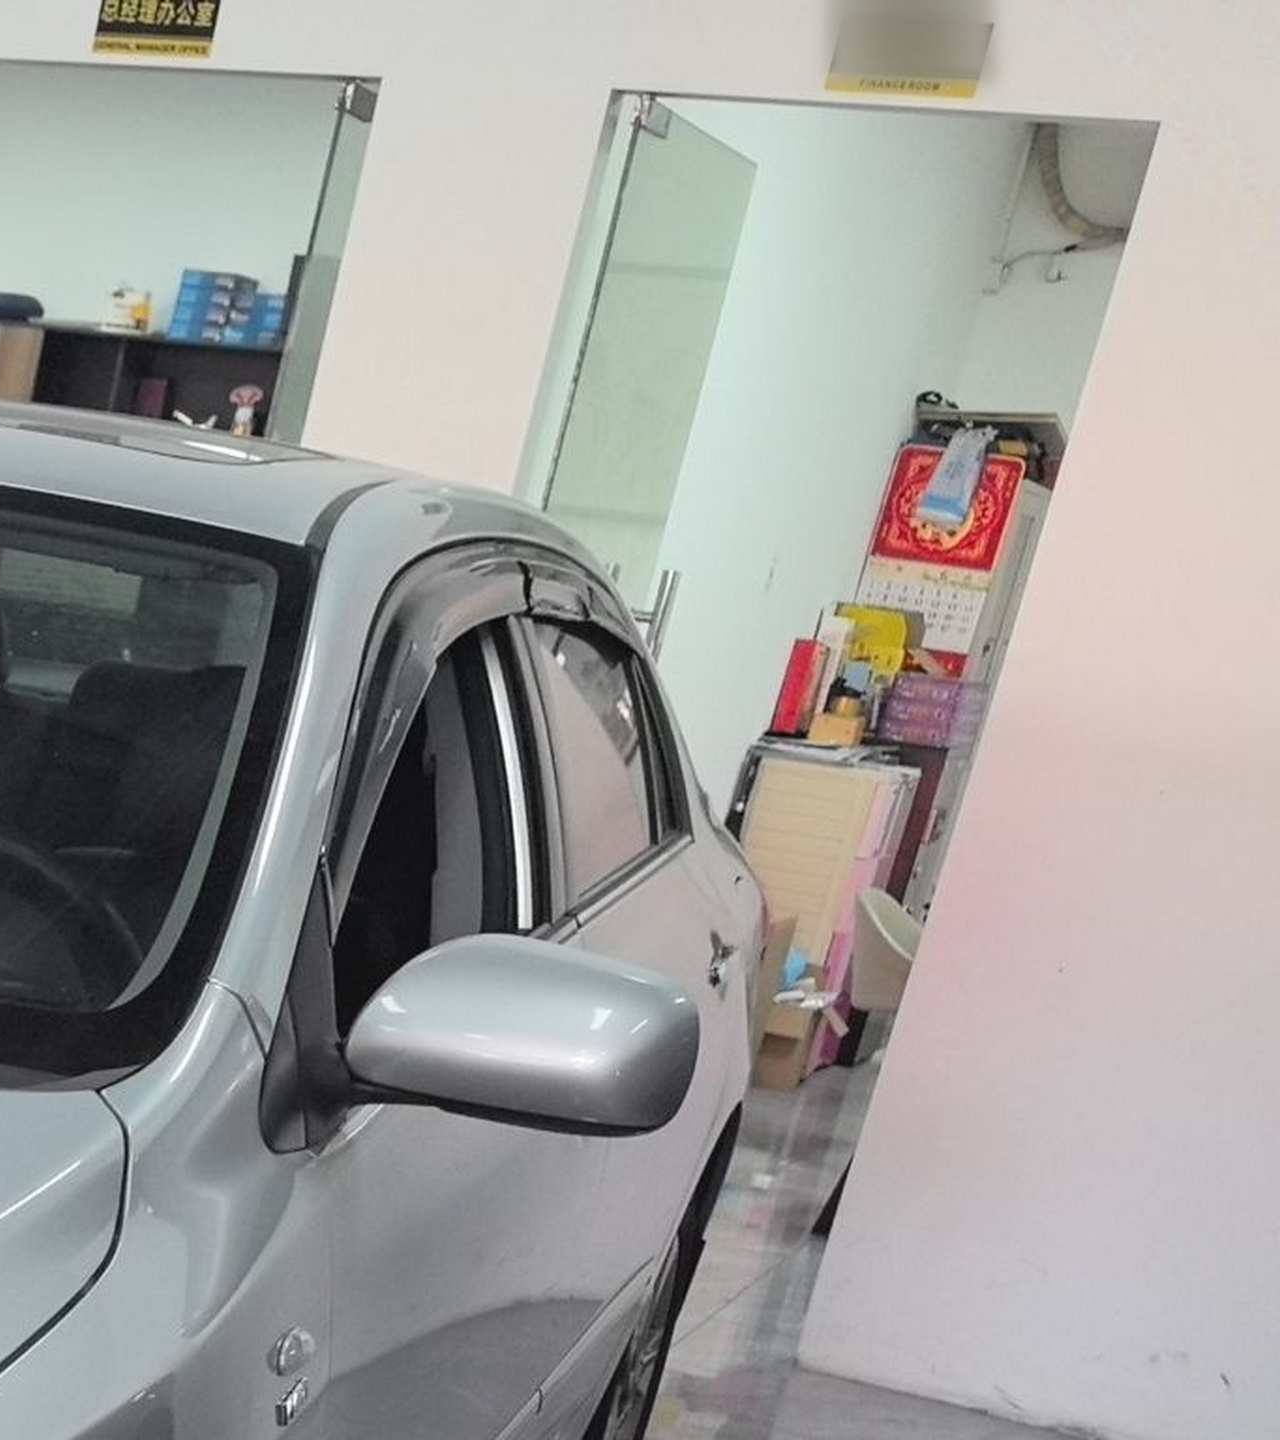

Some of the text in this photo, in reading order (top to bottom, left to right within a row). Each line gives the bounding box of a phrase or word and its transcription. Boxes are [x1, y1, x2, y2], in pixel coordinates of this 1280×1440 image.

[101, 0, 215, 27] 总经理办公室
